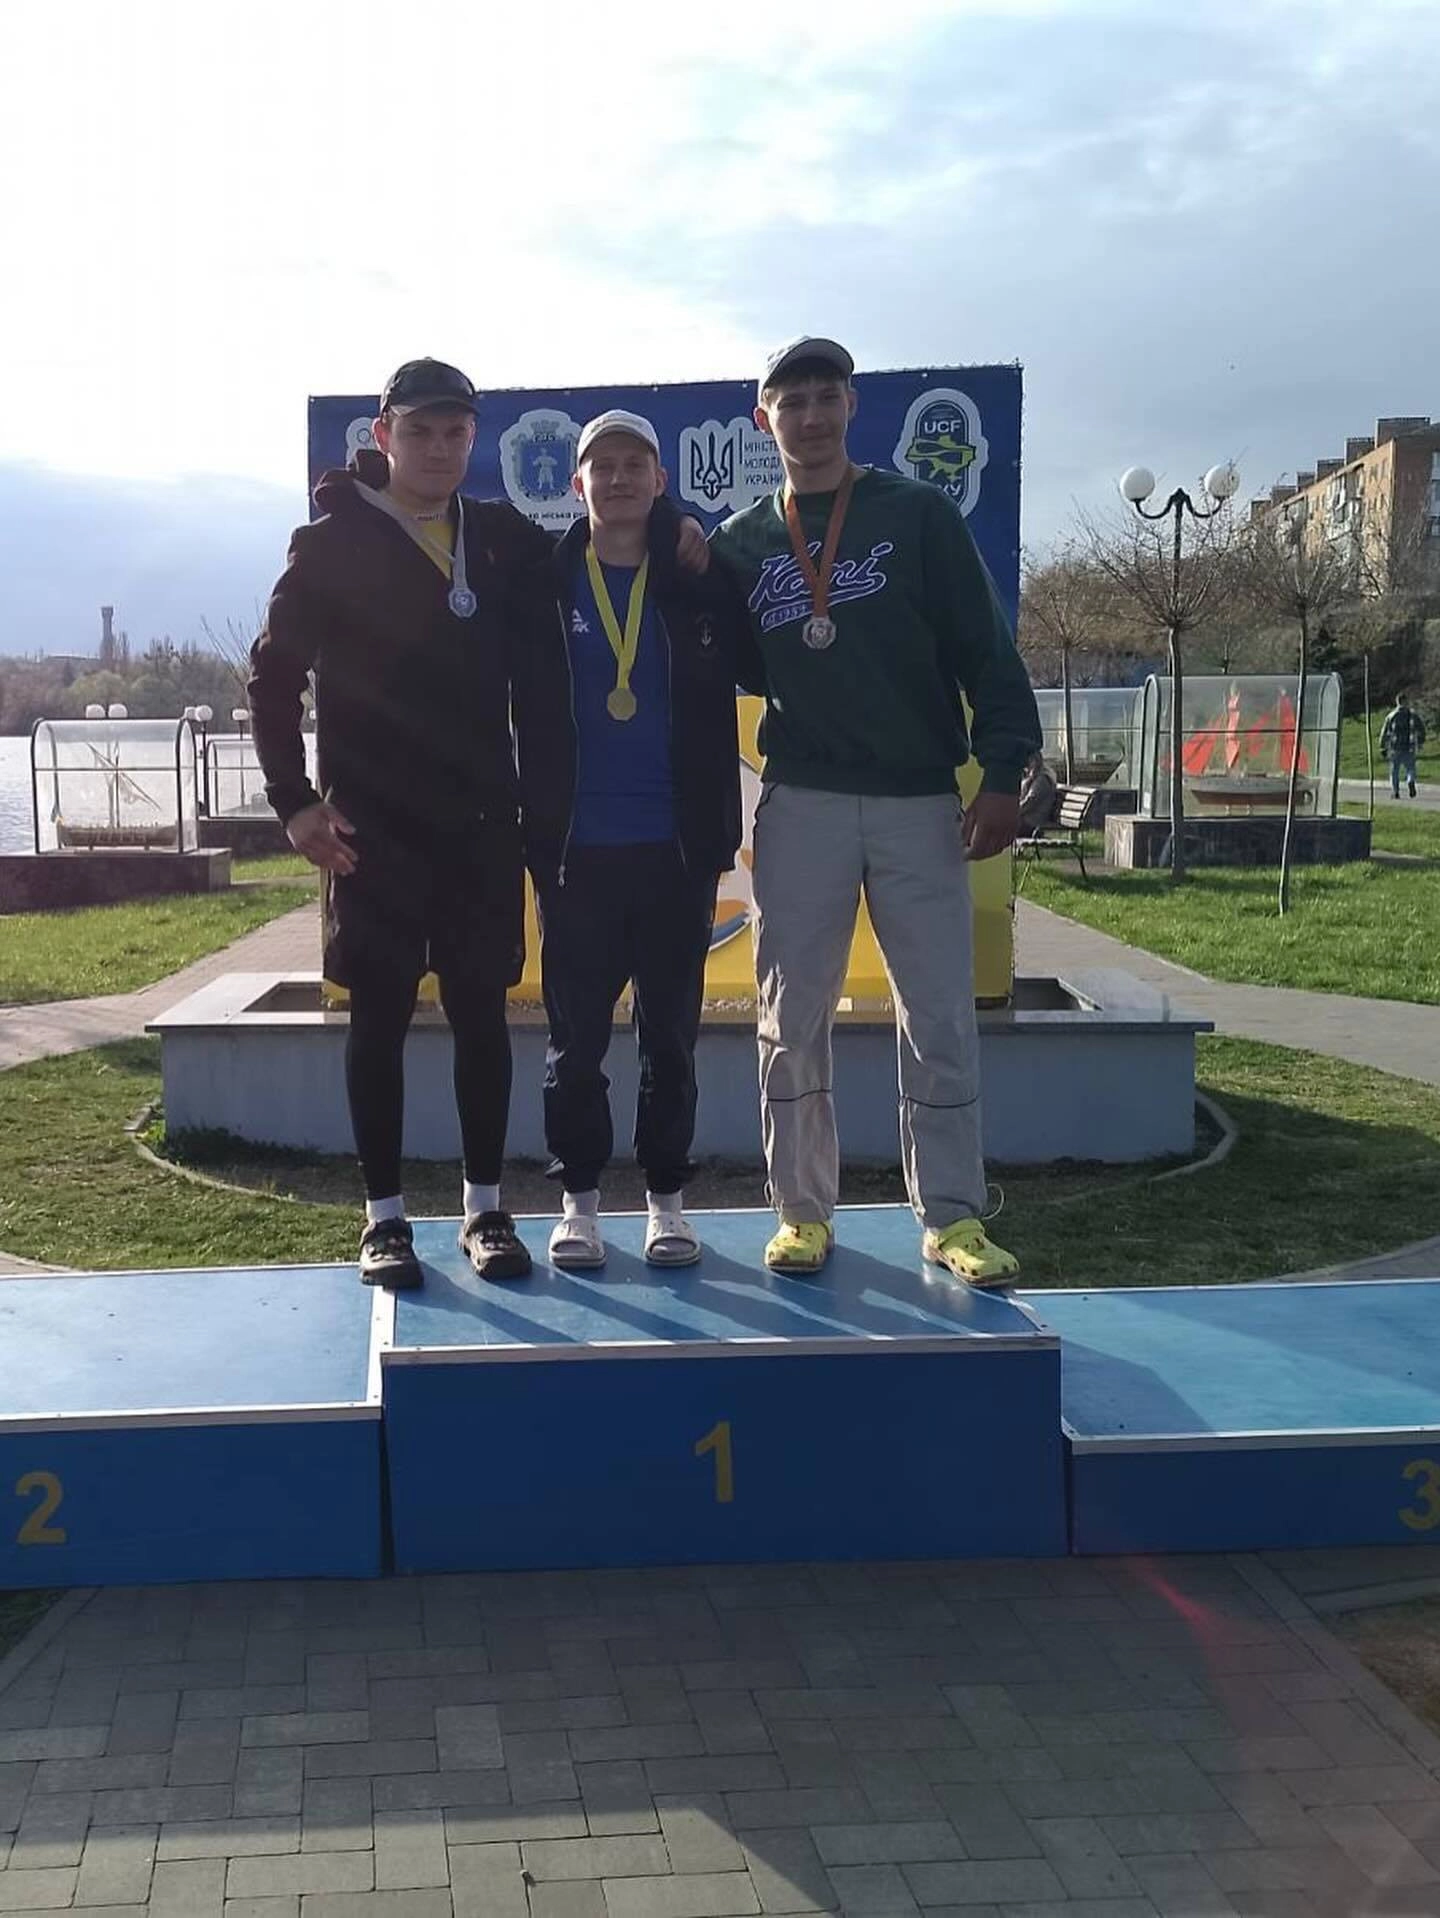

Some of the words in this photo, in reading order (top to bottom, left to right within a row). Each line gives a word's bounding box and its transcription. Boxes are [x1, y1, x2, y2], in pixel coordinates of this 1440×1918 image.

[924, 420, 962, 434] UCF
[695, 1421, 734, 1503] 1
[1398, 1460, 1440, 1530] 3
[16, 1471, 66, 1545] 2
